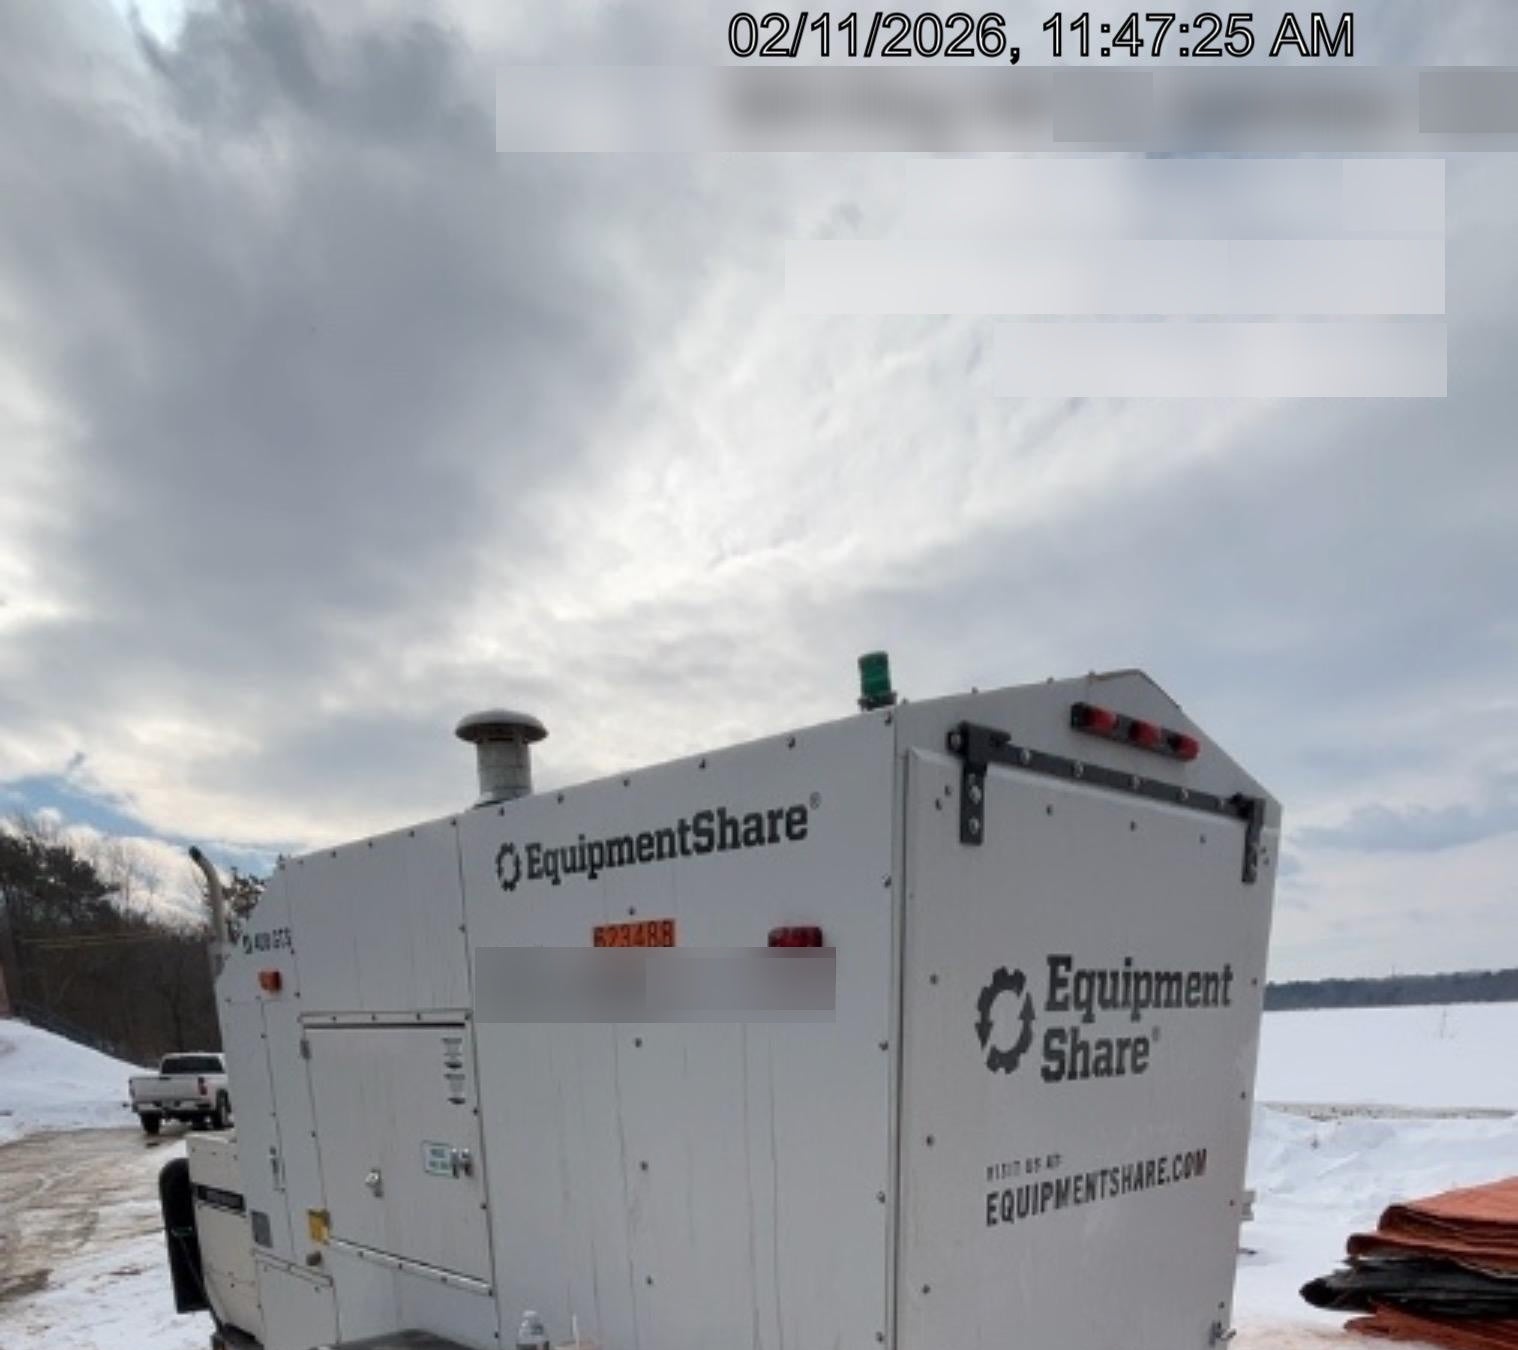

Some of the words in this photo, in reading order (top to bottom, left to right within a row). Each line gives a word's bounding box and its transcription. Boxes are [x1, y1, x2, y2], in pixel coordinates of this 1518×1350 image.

[526, 804, 808, 886] EquipmentShare
[594, 920, 674, 947] 623488
[1045, 954, 1233, 1023] Equipment
[1041, 1026, 1151, 1083] Share
[986, 1149, 1207, 1227] EQUIPMENTSHARE.COM
